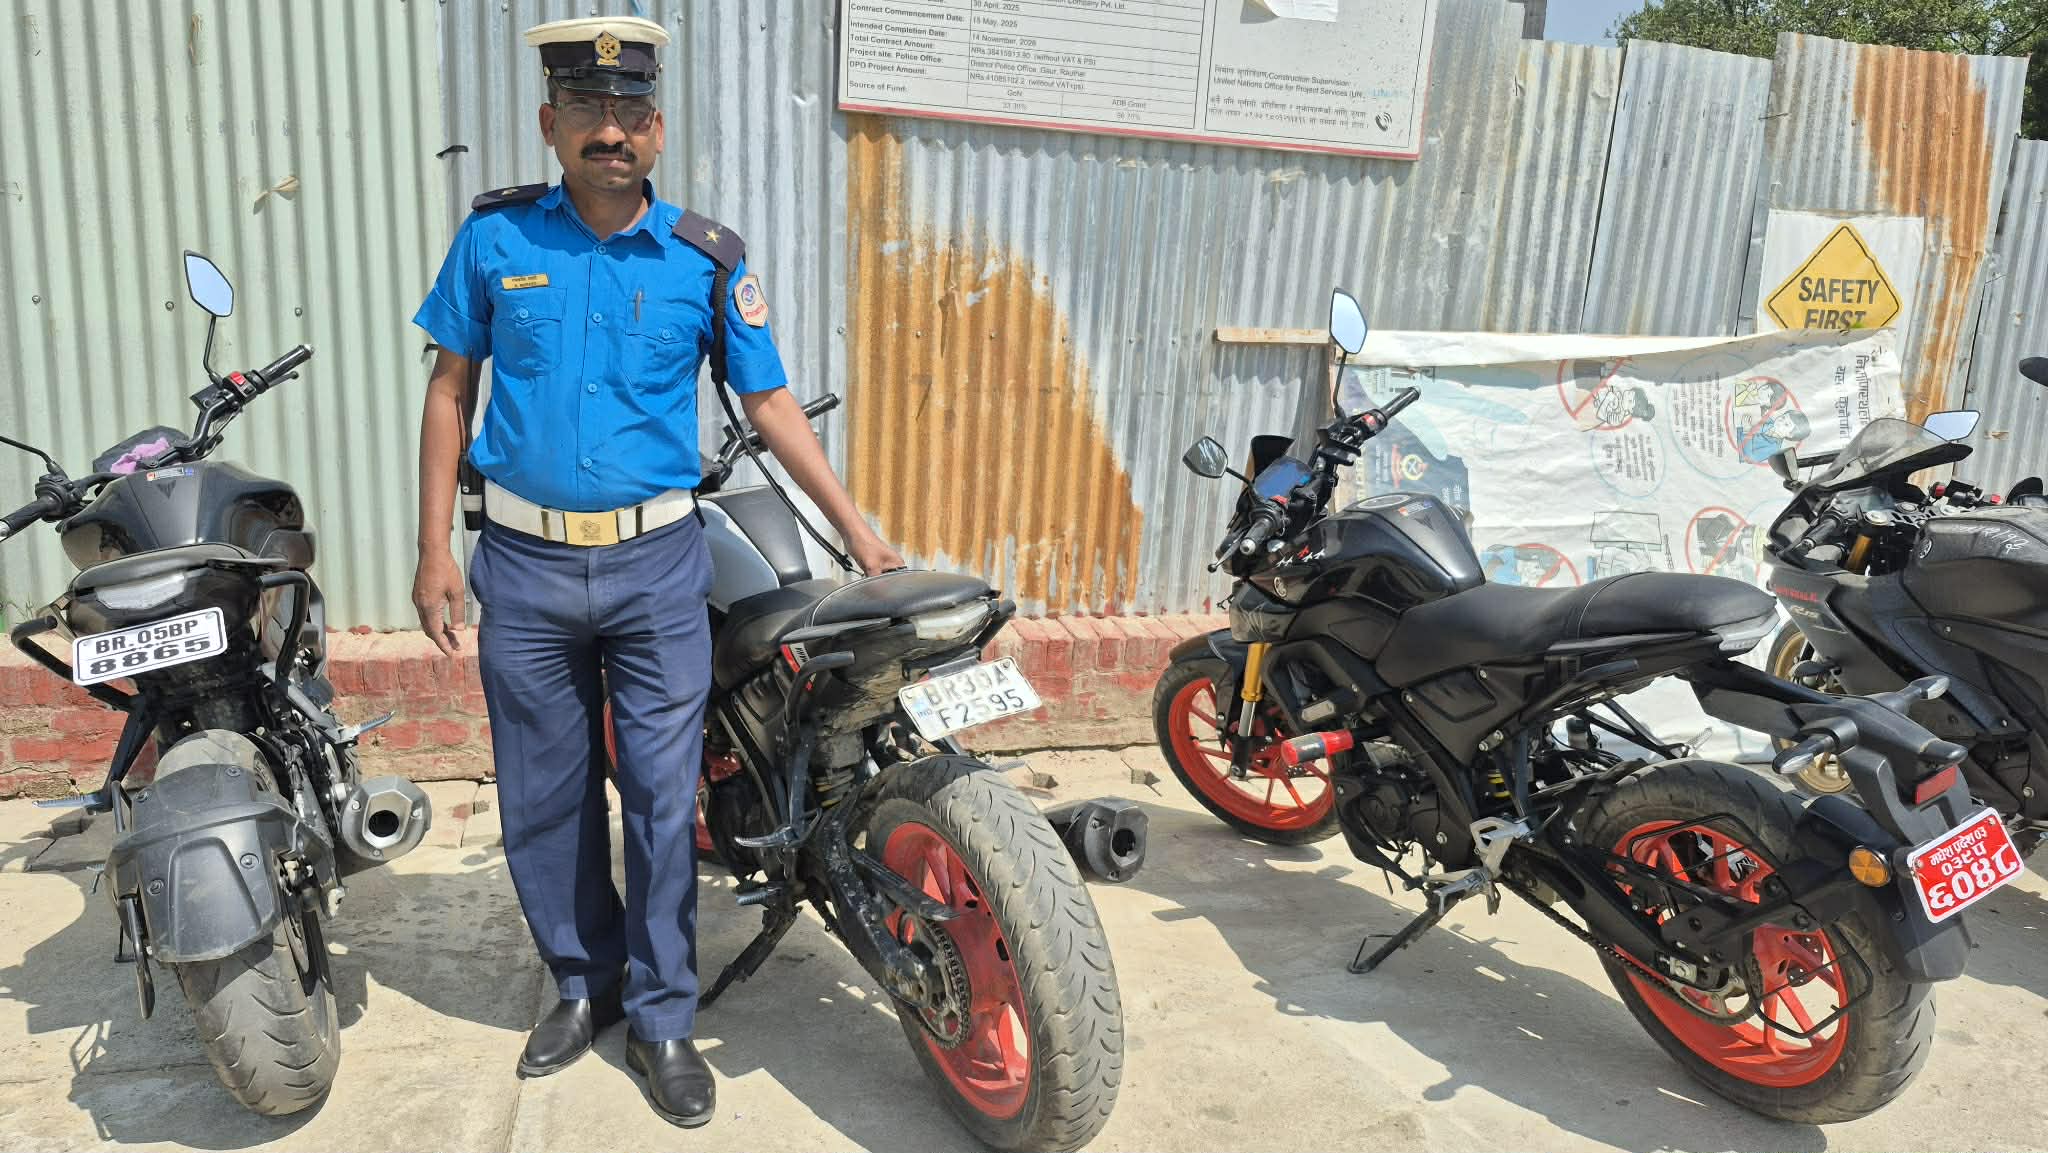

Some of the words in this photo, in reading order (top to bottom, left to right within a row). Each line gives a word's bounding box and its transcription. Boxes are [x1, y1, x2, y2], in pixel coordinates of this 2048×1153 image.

[850, 3, 882, 12] Contract
[884, 6, 944, 19] Commencement
[946, 13, 964, 21] Date:
[850, 20, 882, 29] Intended
[884, 24, 926, 35] Completion
[1000, 19, 1017, 27] 2025
[850, 33, 868, 41] Total
[870, 35, 901, 45] Contract
[904, 39, 934, 49] Amount:
[849, 47, 875, 56] Project
[895, 52, 917, 60] Police
[868, 62, 894, 72] Project
[849, 80, 874, 89] Source
[1213, 77, 1236, 87] United
[1237, 79, 1262, 89] Nations
[1264, 81, 1284, 91] Office
[1296, 84, 1319, 96] Project
[1320, 86, 1349, 98] Services
[1799, 276, 1880, 304] SAFETY
[95, 619, 198, 654] BR.05BP
[90, 636, 211, 675] 8865
[1928, 847, 1954, 866] मधेश
[1952, 834, 1976, 855] प्रदेश
[1928, 843, 2018, 909] ६०४८
